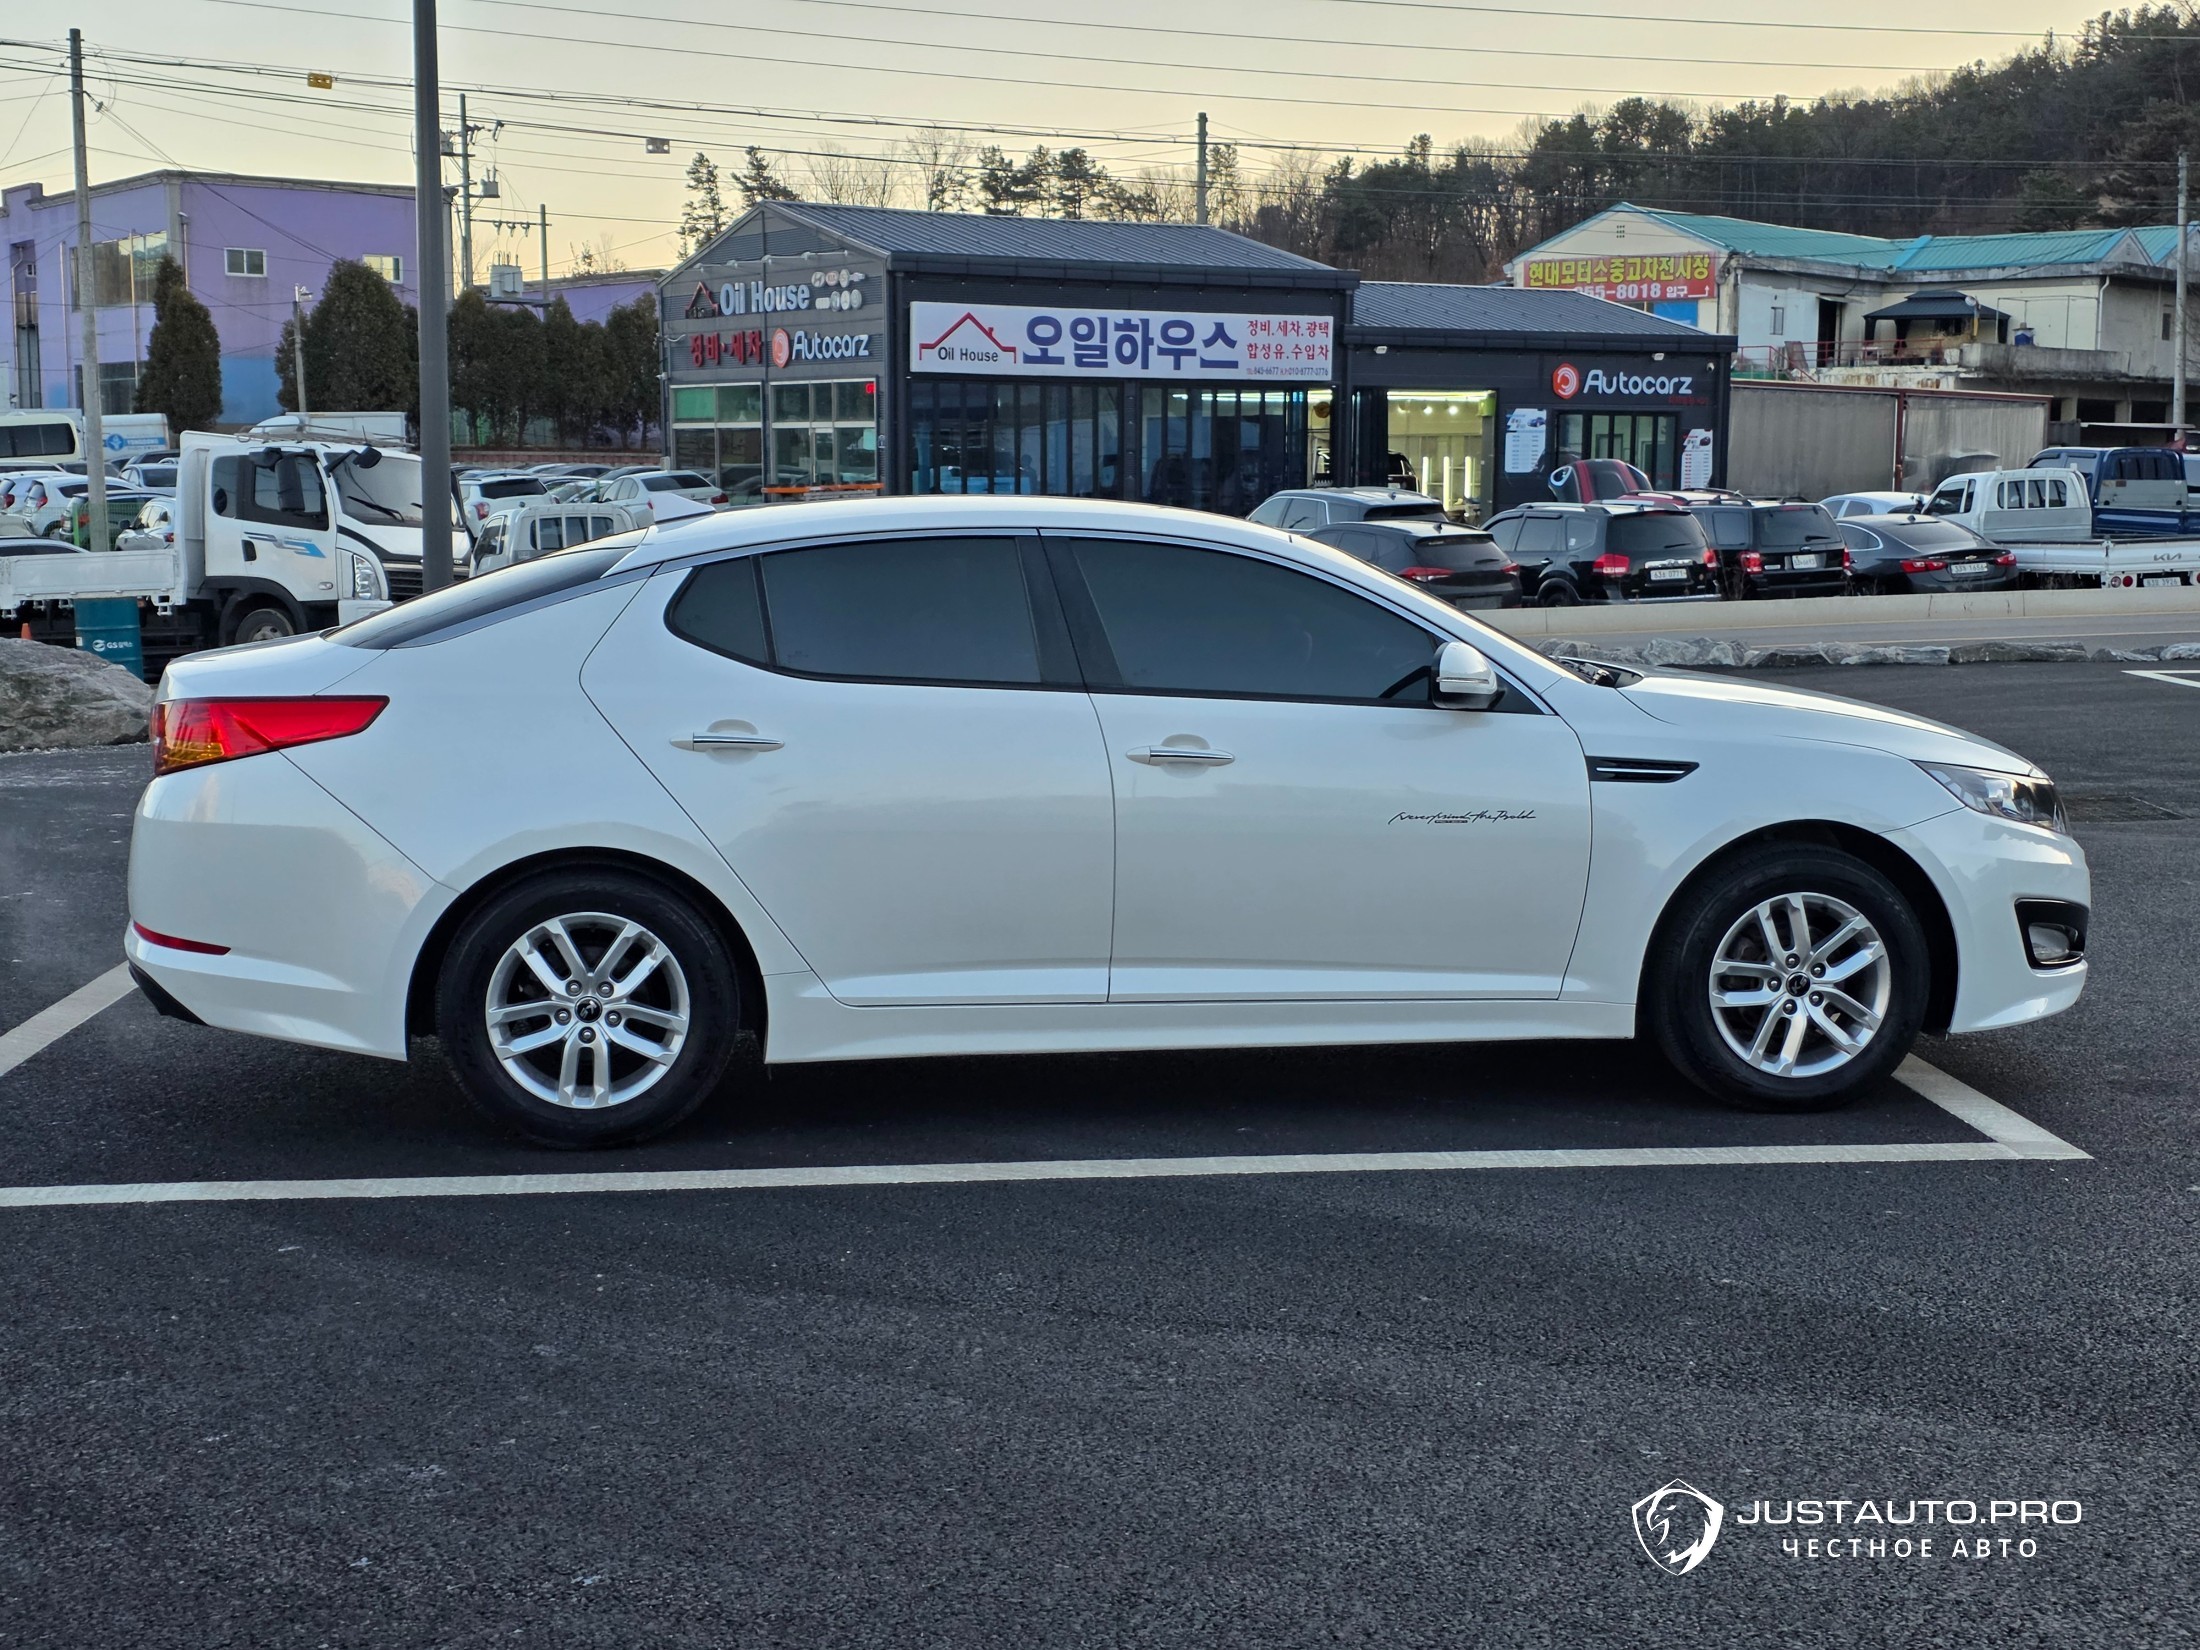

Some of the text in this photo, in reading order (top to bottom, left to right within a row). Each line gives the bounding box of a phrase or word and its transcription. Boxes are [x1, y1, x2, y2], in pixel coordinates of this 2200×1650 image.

[1528, 254, 1710, 287] 현대모터스중고차전시장
[720, 281, 810, 315] Oil House
[1666, 286, 1688, 298] 입구
[791, 330, 870, 361] Autocarz
[937, 346, 999, 362] Oil House
[1022, 315, 1239, 371] 오일하우스
[1583, 369, 1693, 395] Autocarz
